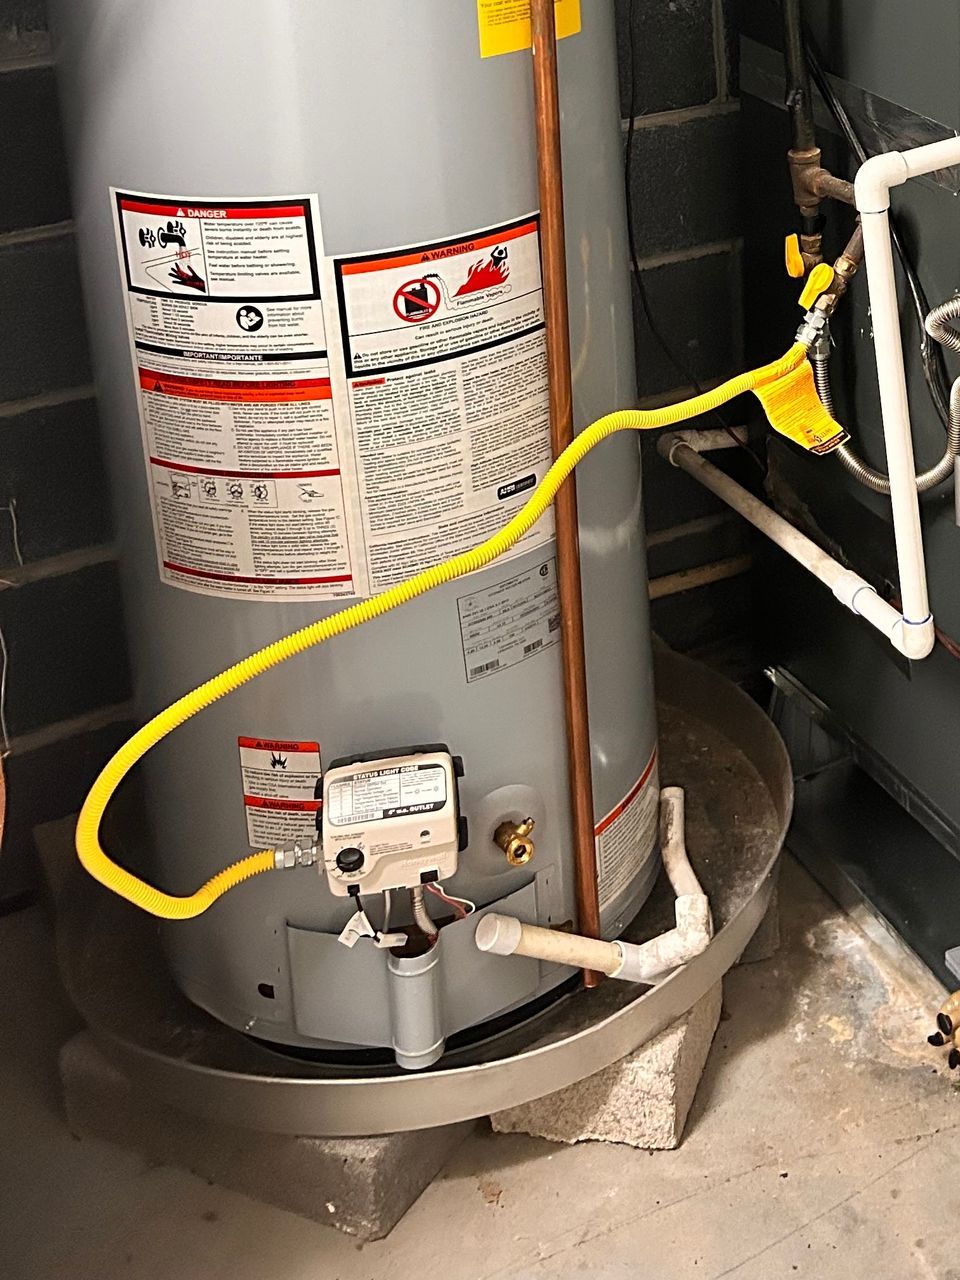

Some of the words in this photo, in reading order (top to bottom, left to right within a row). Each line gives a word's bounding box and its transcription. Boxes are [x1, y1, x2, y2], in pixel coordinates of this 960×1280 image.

[188, 209, 227, 218] DANGER
[431, 243, 475, 260] WARNING
[353, 771, 379, 780] STATUS
[380, 768, 400, 776] LIGHT
